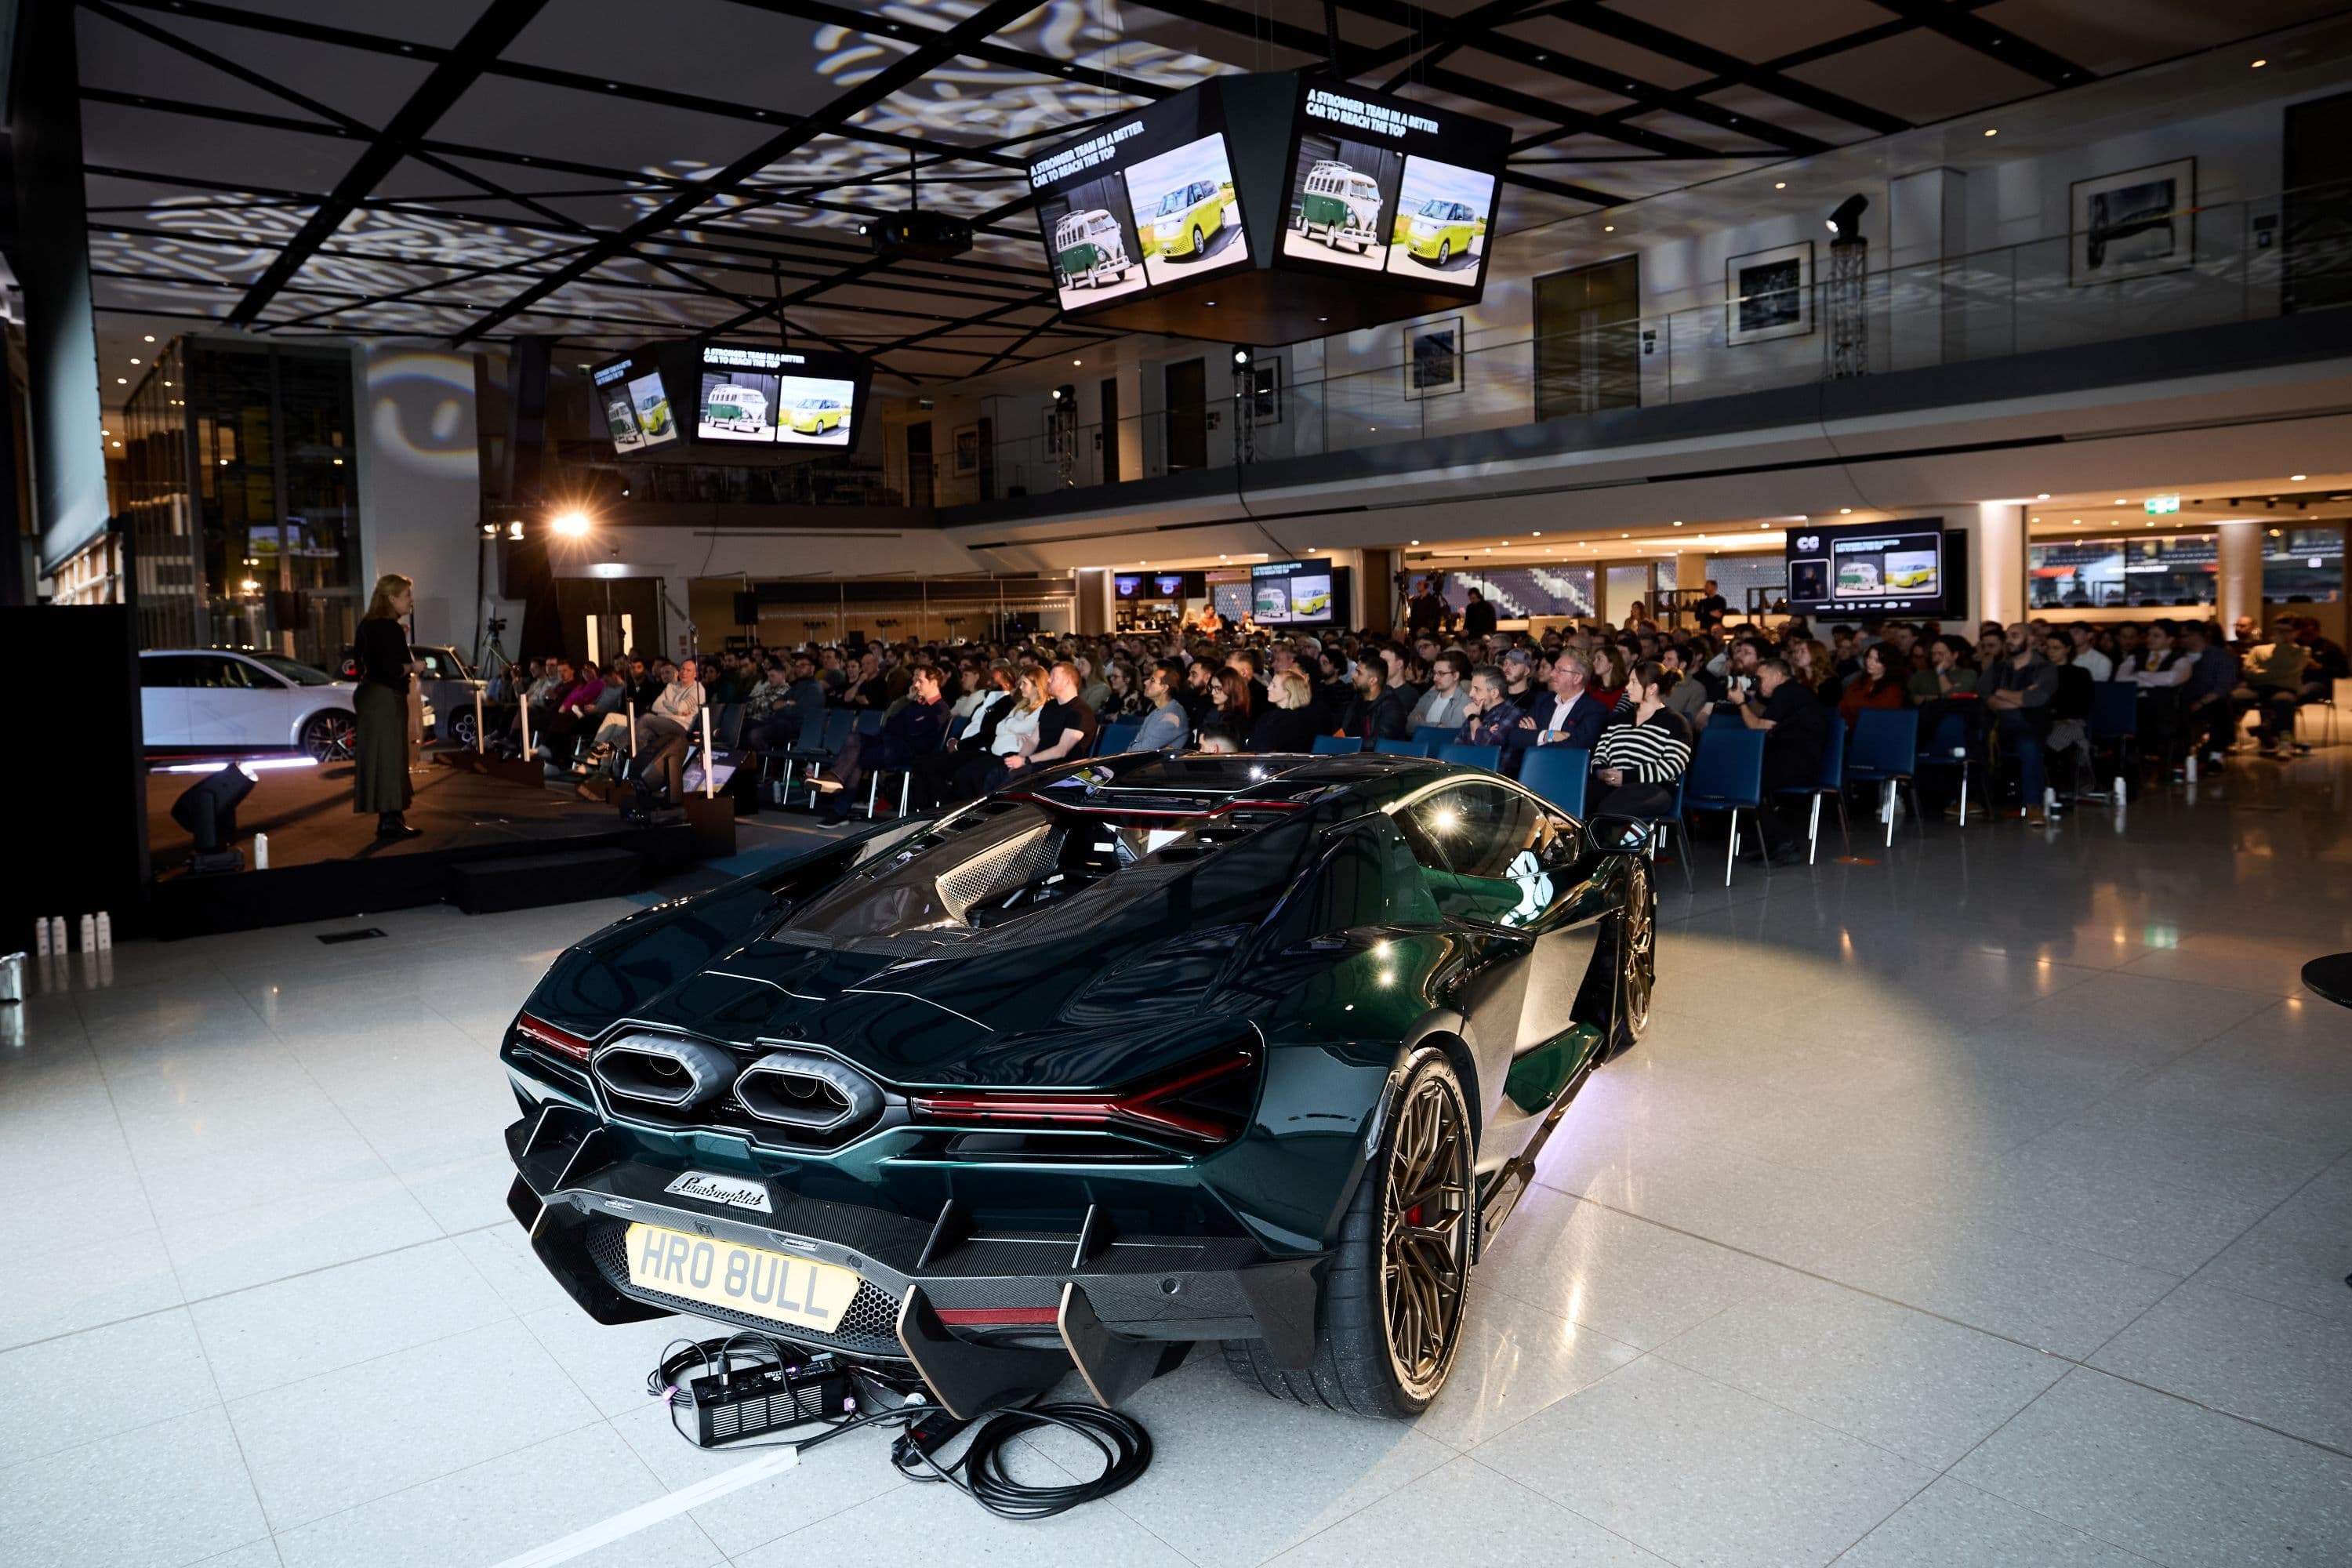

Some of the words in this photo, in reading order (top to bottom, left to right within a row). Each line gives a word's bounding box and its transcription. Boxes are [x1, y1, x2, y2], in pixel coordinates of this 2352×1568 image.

[1305, 102, 1326, 118] CAR
[1327, 107, 1340, 121] TO
[1340, 111, 1370, 129] REACH
[1371, 118, 1388, 134] THE
[1388, 123, 1406, 138] TOP
[1307, 89, 1316, 102] A
[1316, 91, 1364, 114] STRONGER
[1366, 103, 1390, 121] TEAM
[1390, 111, 1400, 123] IN
[1400, 114, 1407, 125] A
[1408, 115, 1439, 134] BETTER
[1031, 165, 1037, 177] A
[1036, 150, 1076, 174] STRONGER
[1075, 140, 1097, 158] TEAM
[1097, 136, 1106, 149] IN
[1106, 133, 1114, 146] A
[1113, 121, 1145, 143] BETTER
[1033, 173, 1048, 188] CAR
[1047, 169, 1058, 182] TO
[1058, 158, 1083, 178] REACH
[1083, 152, 1099, 168] THE
[1098, 146, 1116, 162] TOP
[719, 356, 729, 365] TO
[753, 358, 766, 368] THE
[766, 360, 781, 368] TOP
[673, 1177, 764, 1206] Lamborghini
